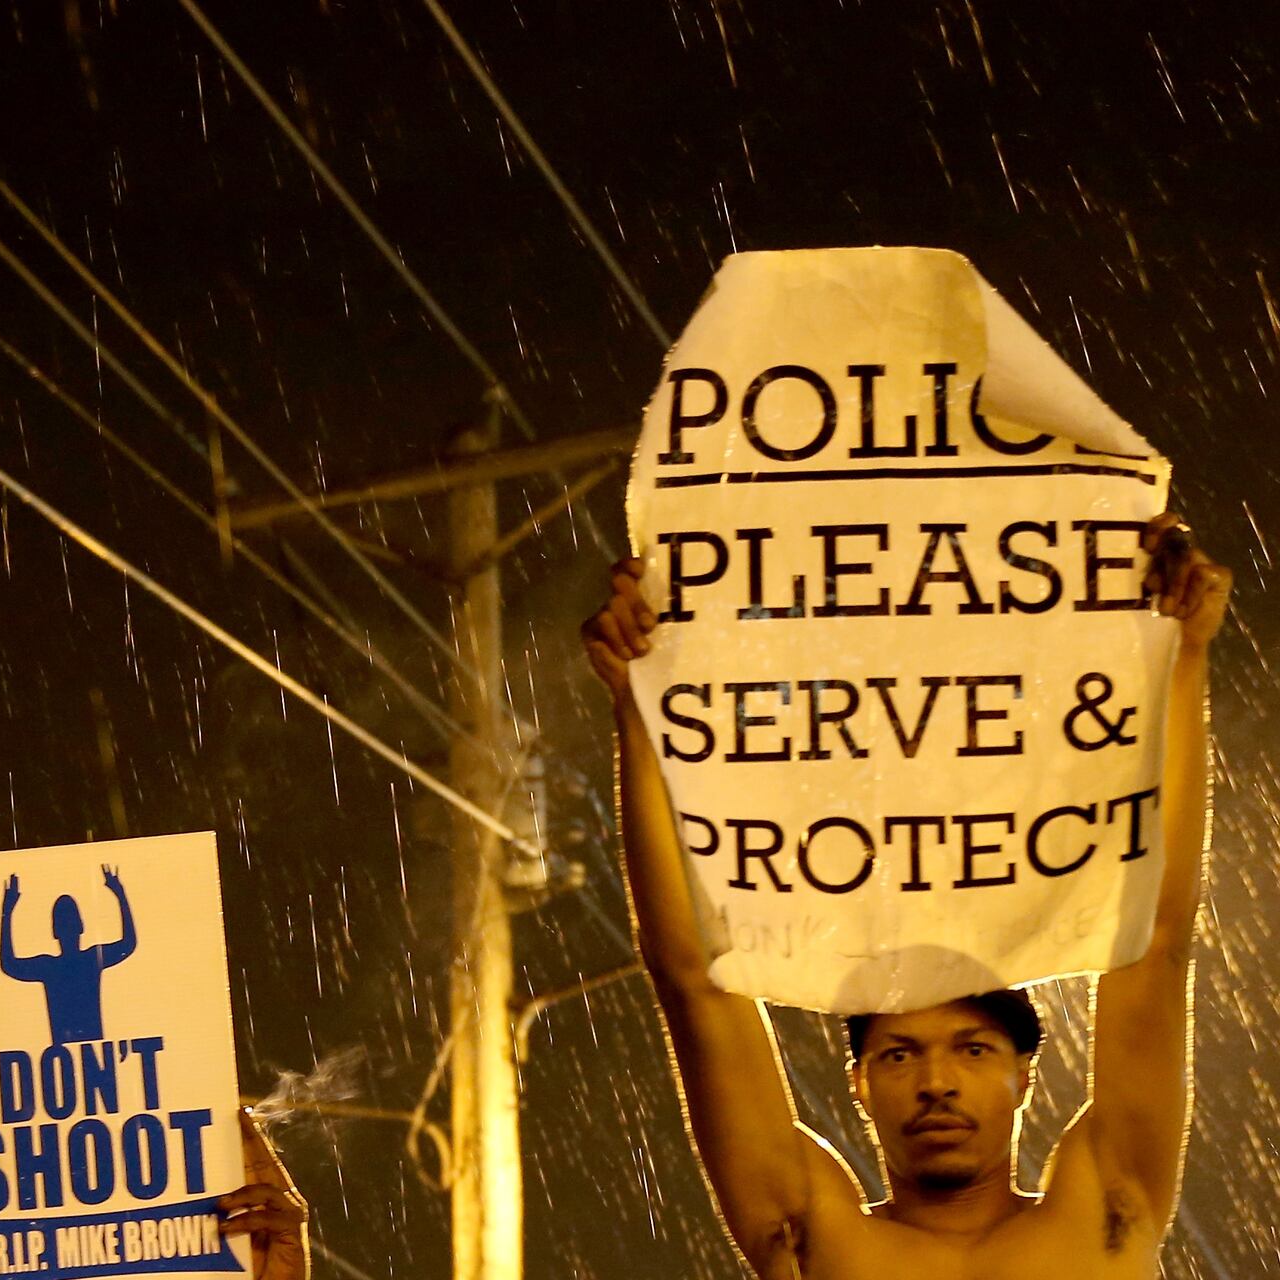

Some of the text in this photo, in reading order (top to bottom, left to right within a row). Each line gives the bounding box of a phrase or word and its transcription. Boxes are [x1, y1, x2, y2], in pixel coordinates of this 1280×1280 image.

[657, 363, 1149, 463] POLIC
[657, 521, 1153, 623] PLEASE
[662, 671, 1138, 764] SERVE &
[56, 1222, 122, 1270] MIKE
[123, 1213, 221, 1263] BROWN
